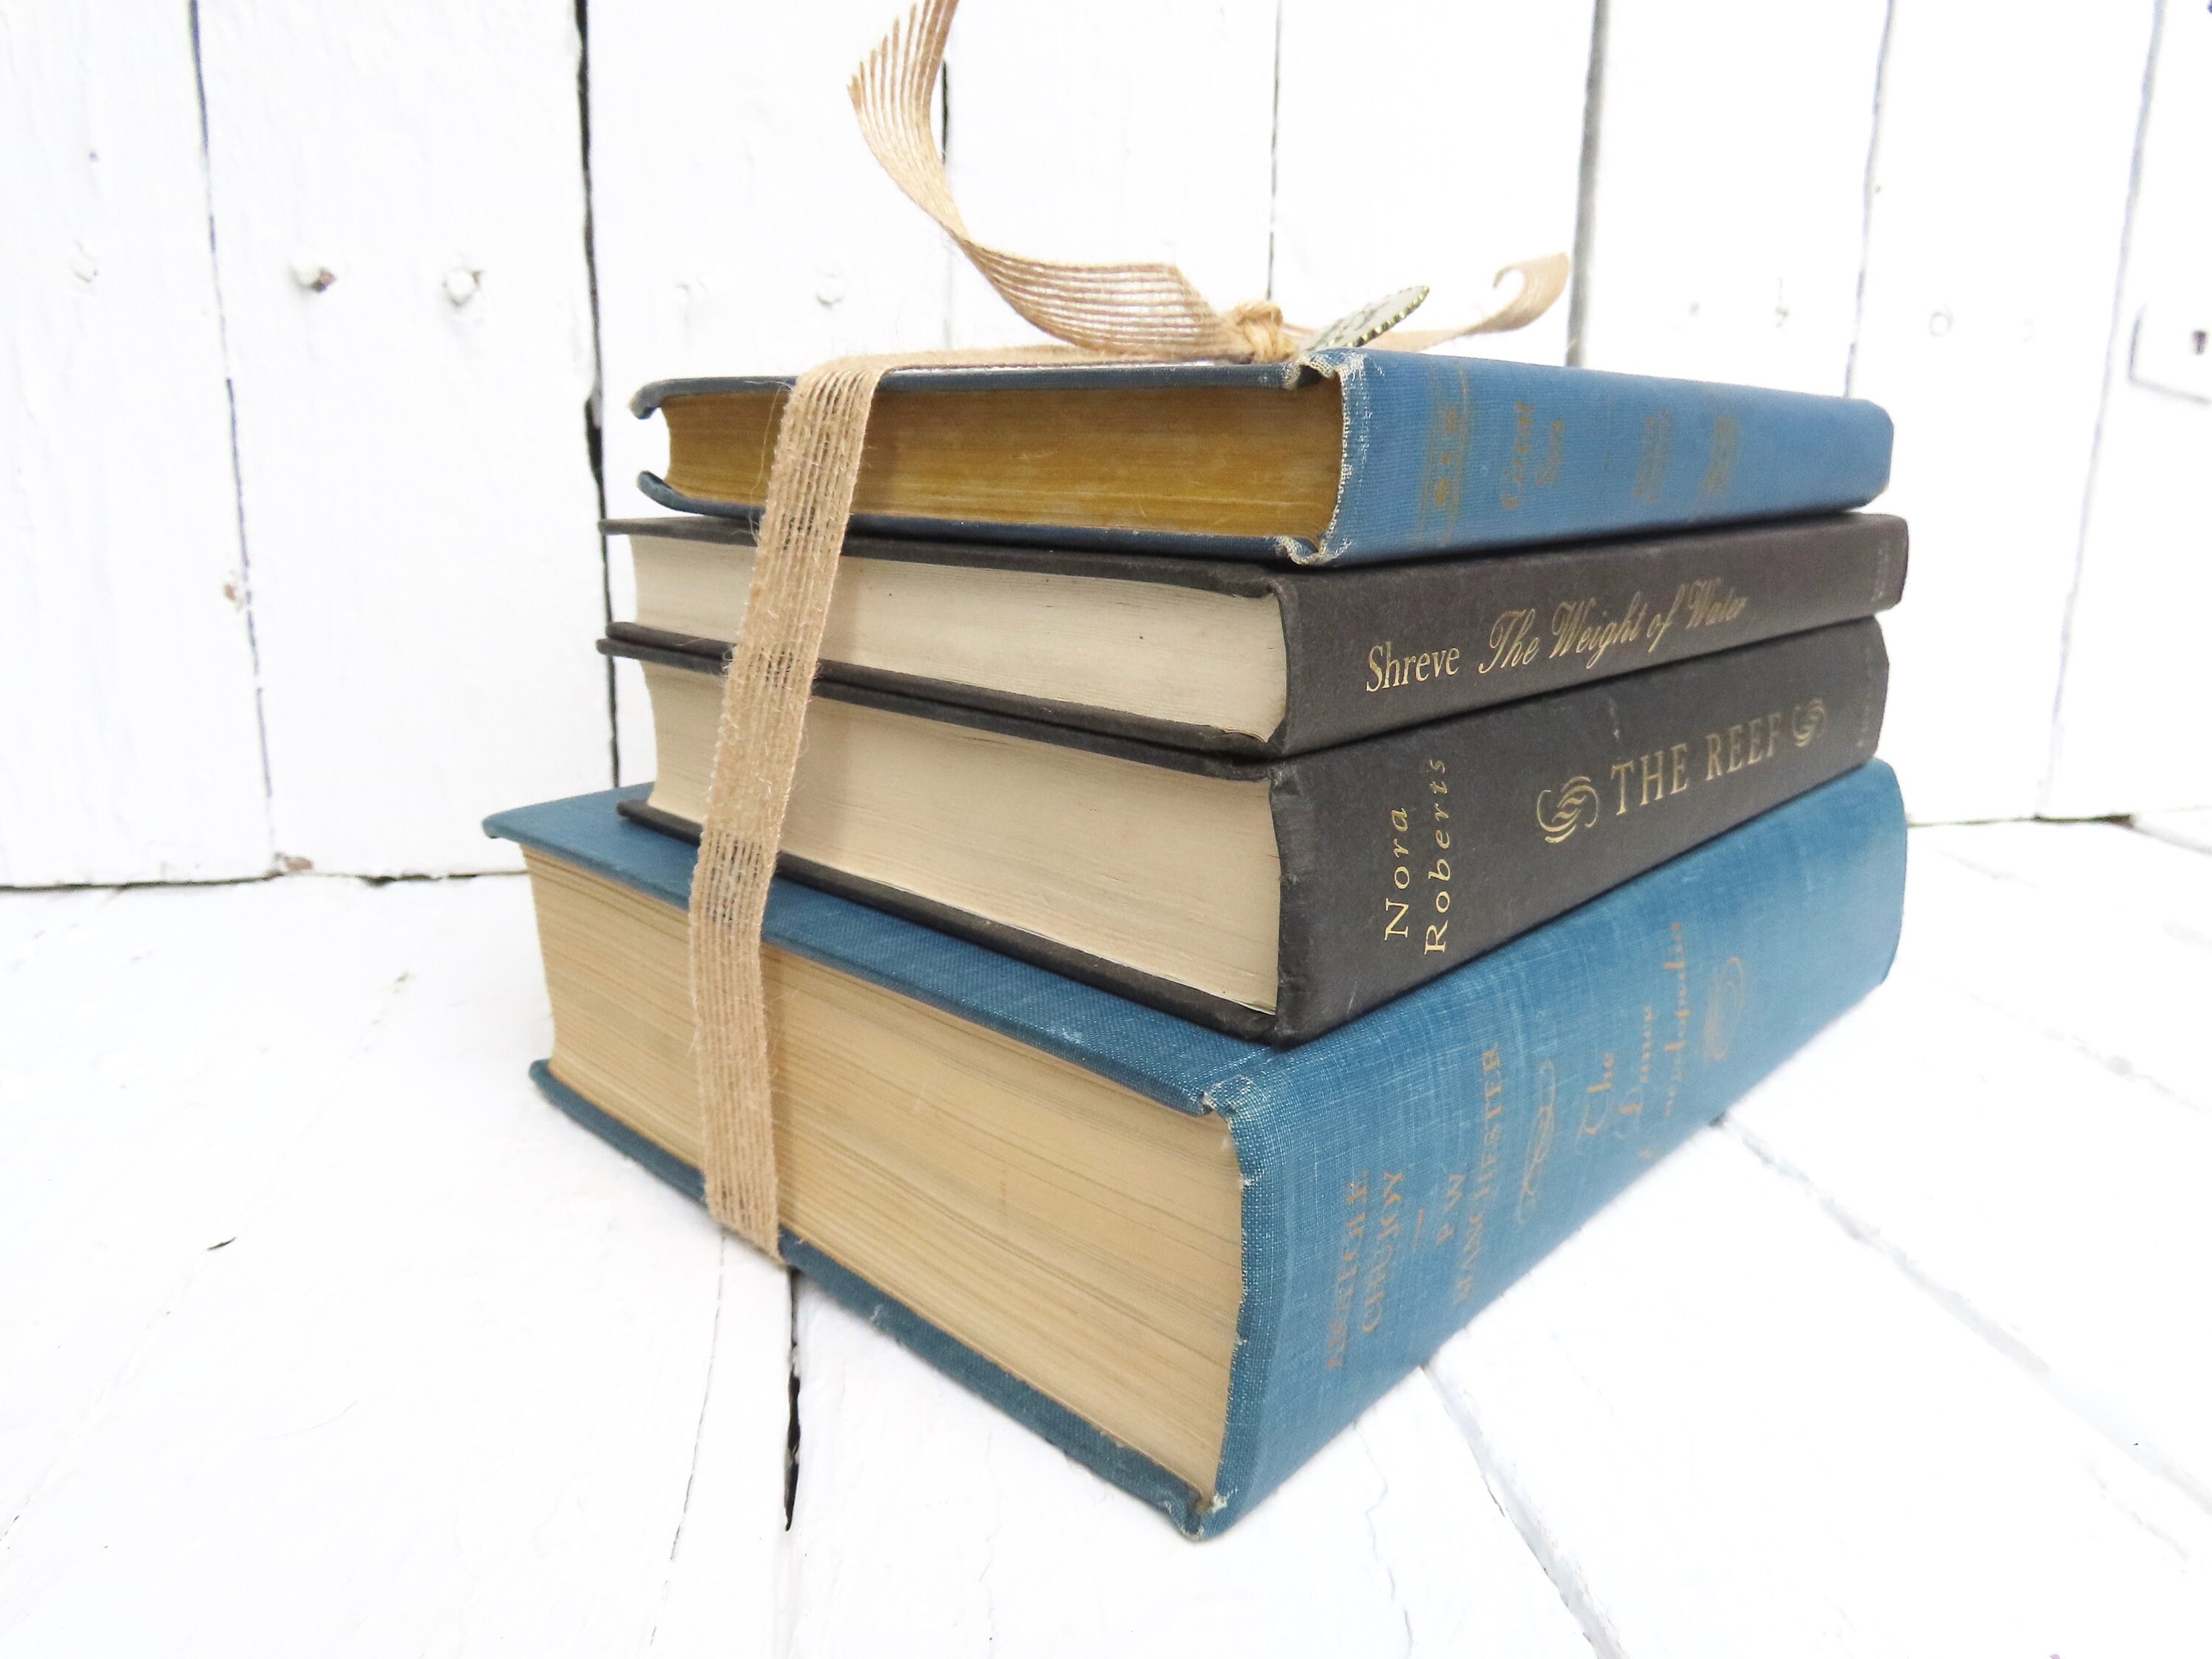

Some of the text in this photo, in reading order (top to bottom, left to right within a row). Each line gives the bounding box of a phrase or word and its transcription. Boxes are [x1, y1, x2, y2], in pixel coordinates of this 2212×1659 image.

[1365, 580, 1747, 693] Shreve The Weight of Water
[1611, 712, 1786, 815] THE REEF
[1383, 807, 1411, 941] Nora
[1424, 758, 1454, 956] Roberts
